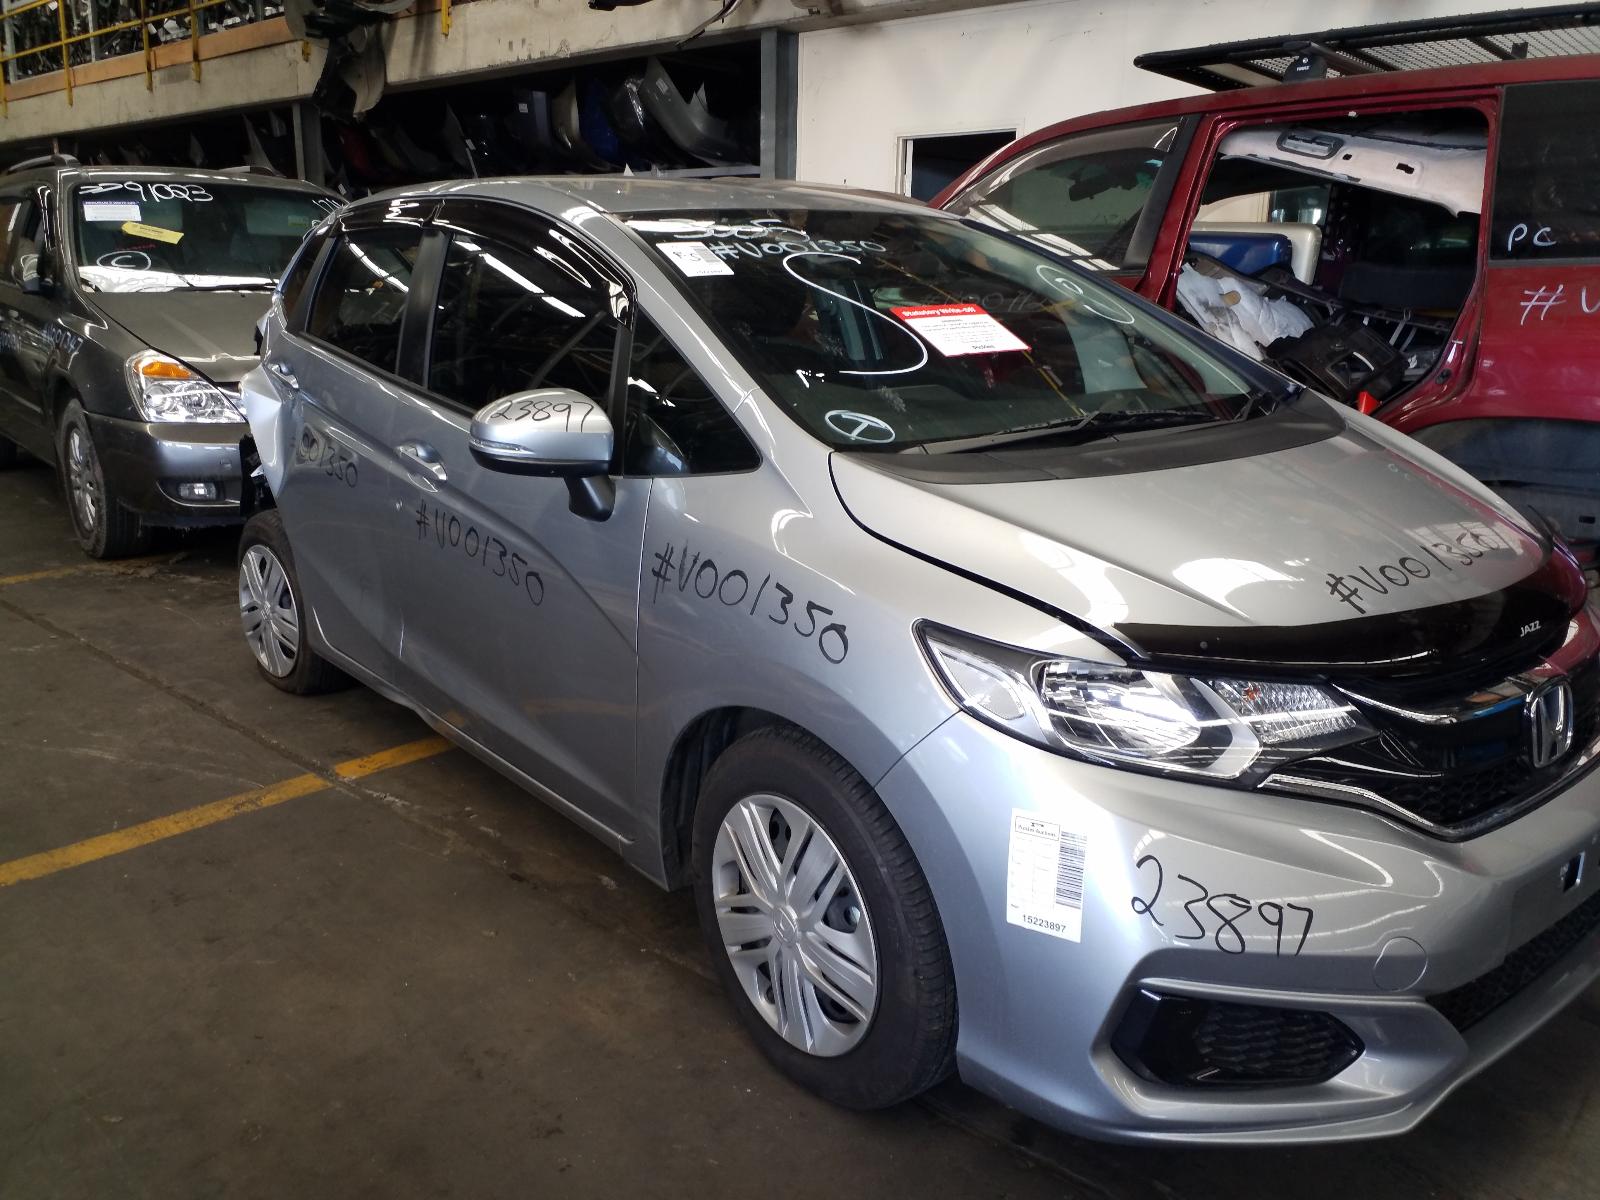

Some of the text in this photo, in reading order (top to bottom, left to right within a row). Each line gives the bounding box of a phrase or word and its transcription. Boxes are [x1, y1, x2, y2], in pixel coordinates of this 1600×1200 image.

[490, 399, 595, 433] 23897
[651, 539, 849, 665] #V001350
[1519, 619, 1542, 638] JAZZ
[1022, 912, 1067, 933] 15223897
[1130, 854, 1315, 957] 23897
